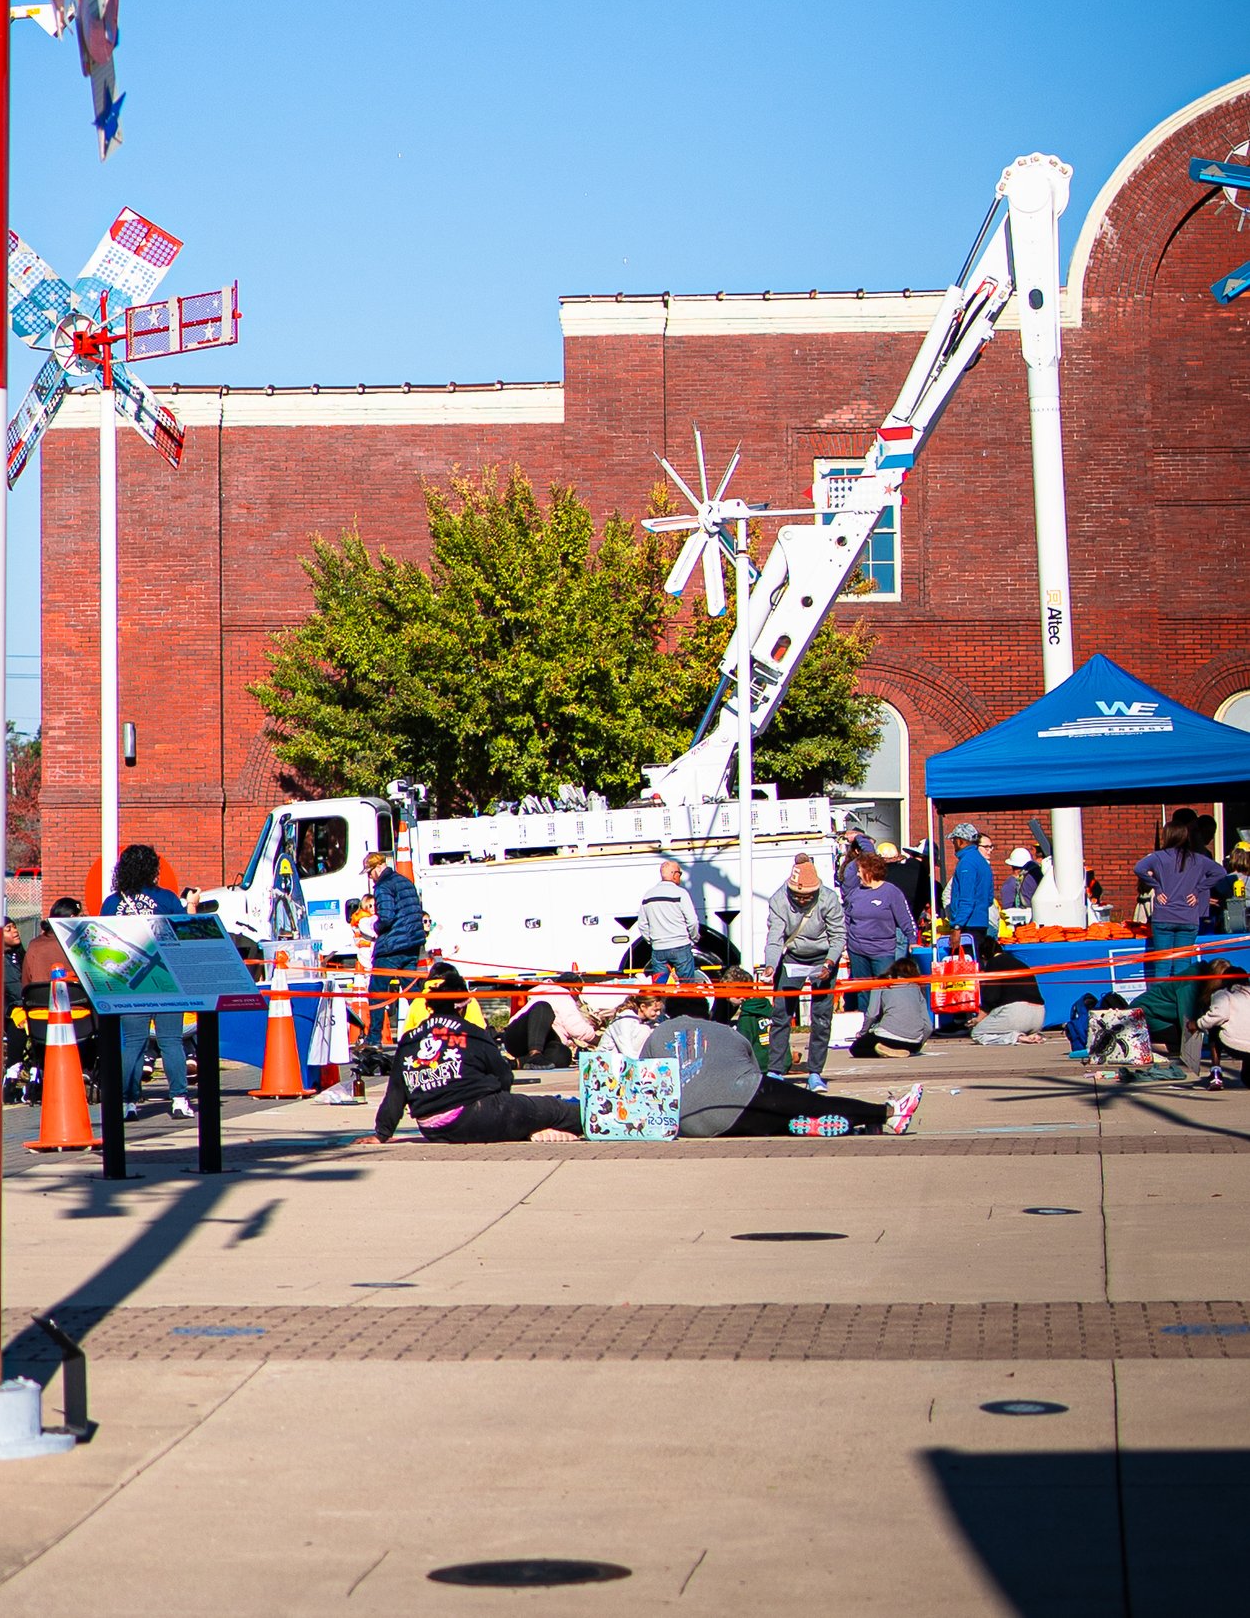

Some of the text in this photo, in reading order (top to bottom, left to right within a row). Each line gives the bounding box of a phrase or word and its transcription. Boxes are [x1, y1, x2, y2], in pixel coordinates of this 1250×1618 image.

[1047, 606, 1062, 645] Altec
[1095, 700, 1159, 716] WE
[320, 922, 334, 931] 104
